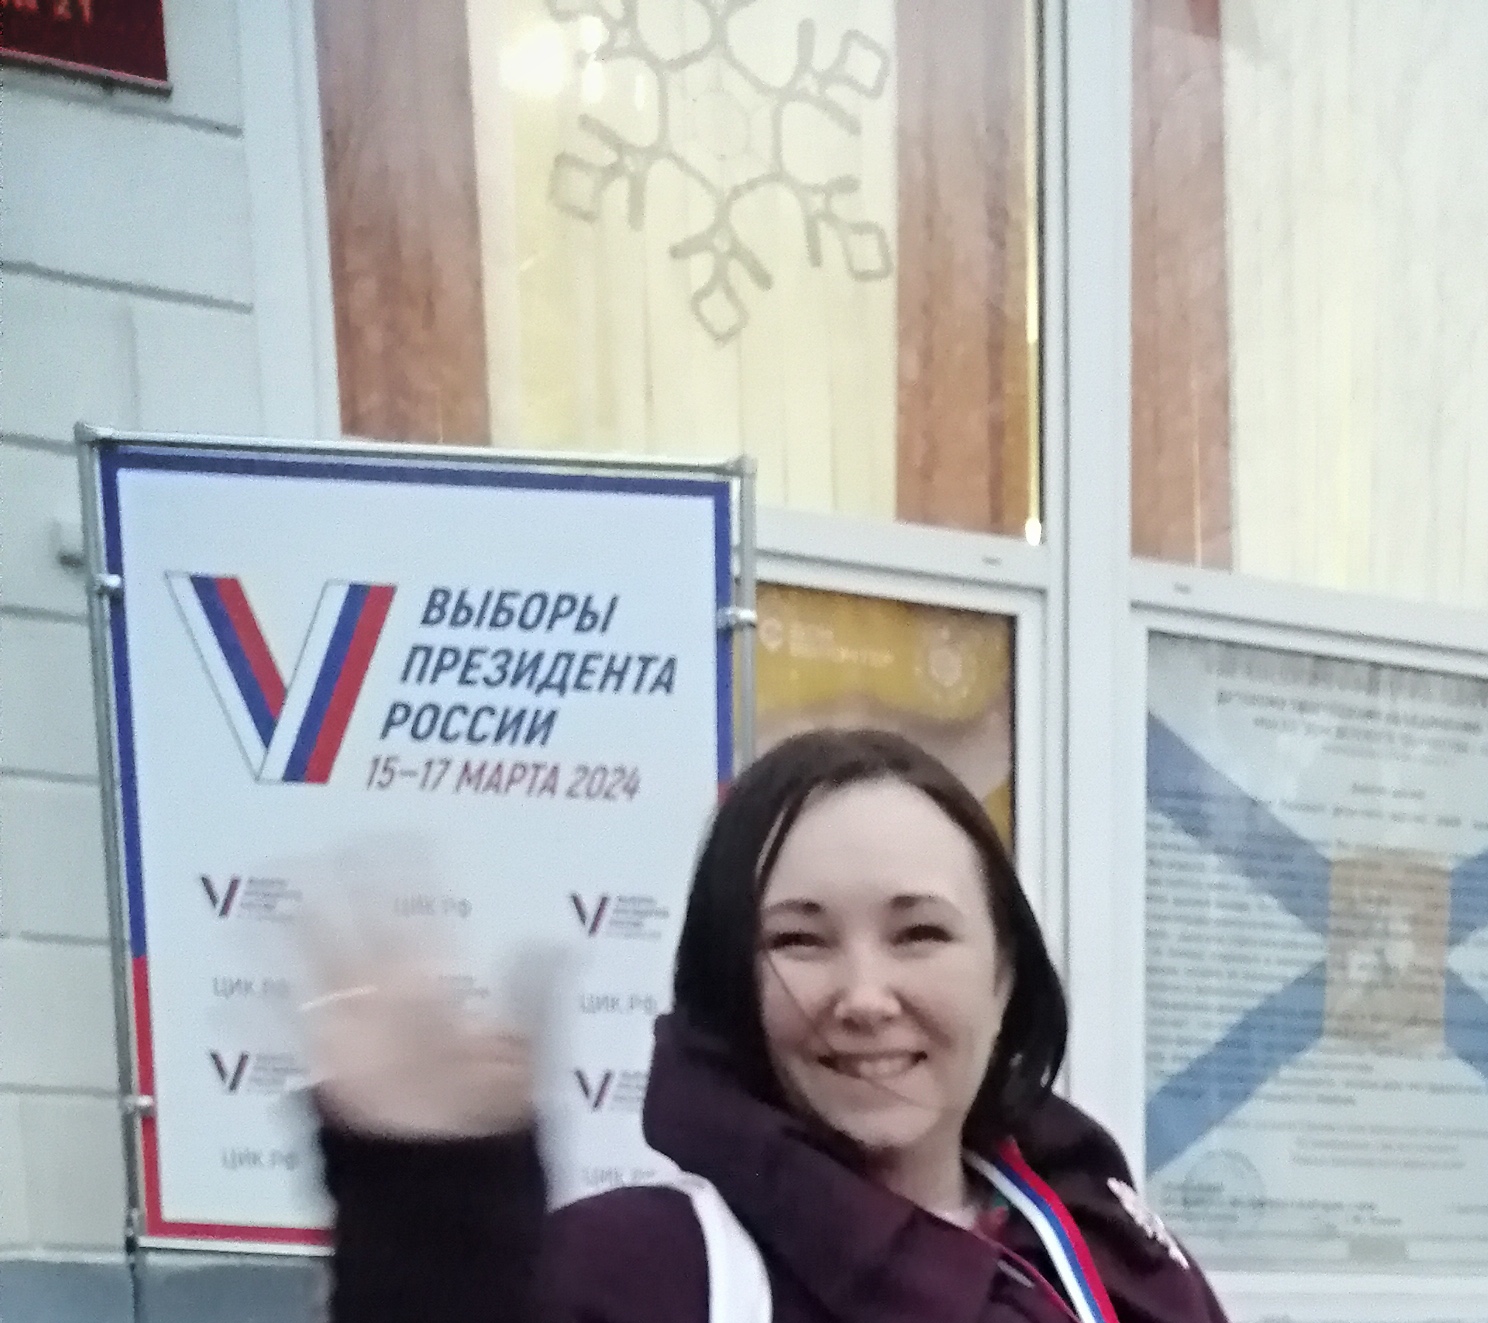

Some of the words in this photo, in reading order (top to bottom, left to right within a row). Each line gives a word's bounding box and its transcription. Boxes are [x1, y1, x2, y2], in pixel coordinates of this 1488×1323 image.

[420, 586, 620, 634] ВЫБОРЫ
[399, 642, 678, 698] ПРЕЗИДЕНТА
[379, 700, 559, 747] РОССИИ
[454, 758, 560, 798] МАРТА
[564, 762, 642, 801] 2024
